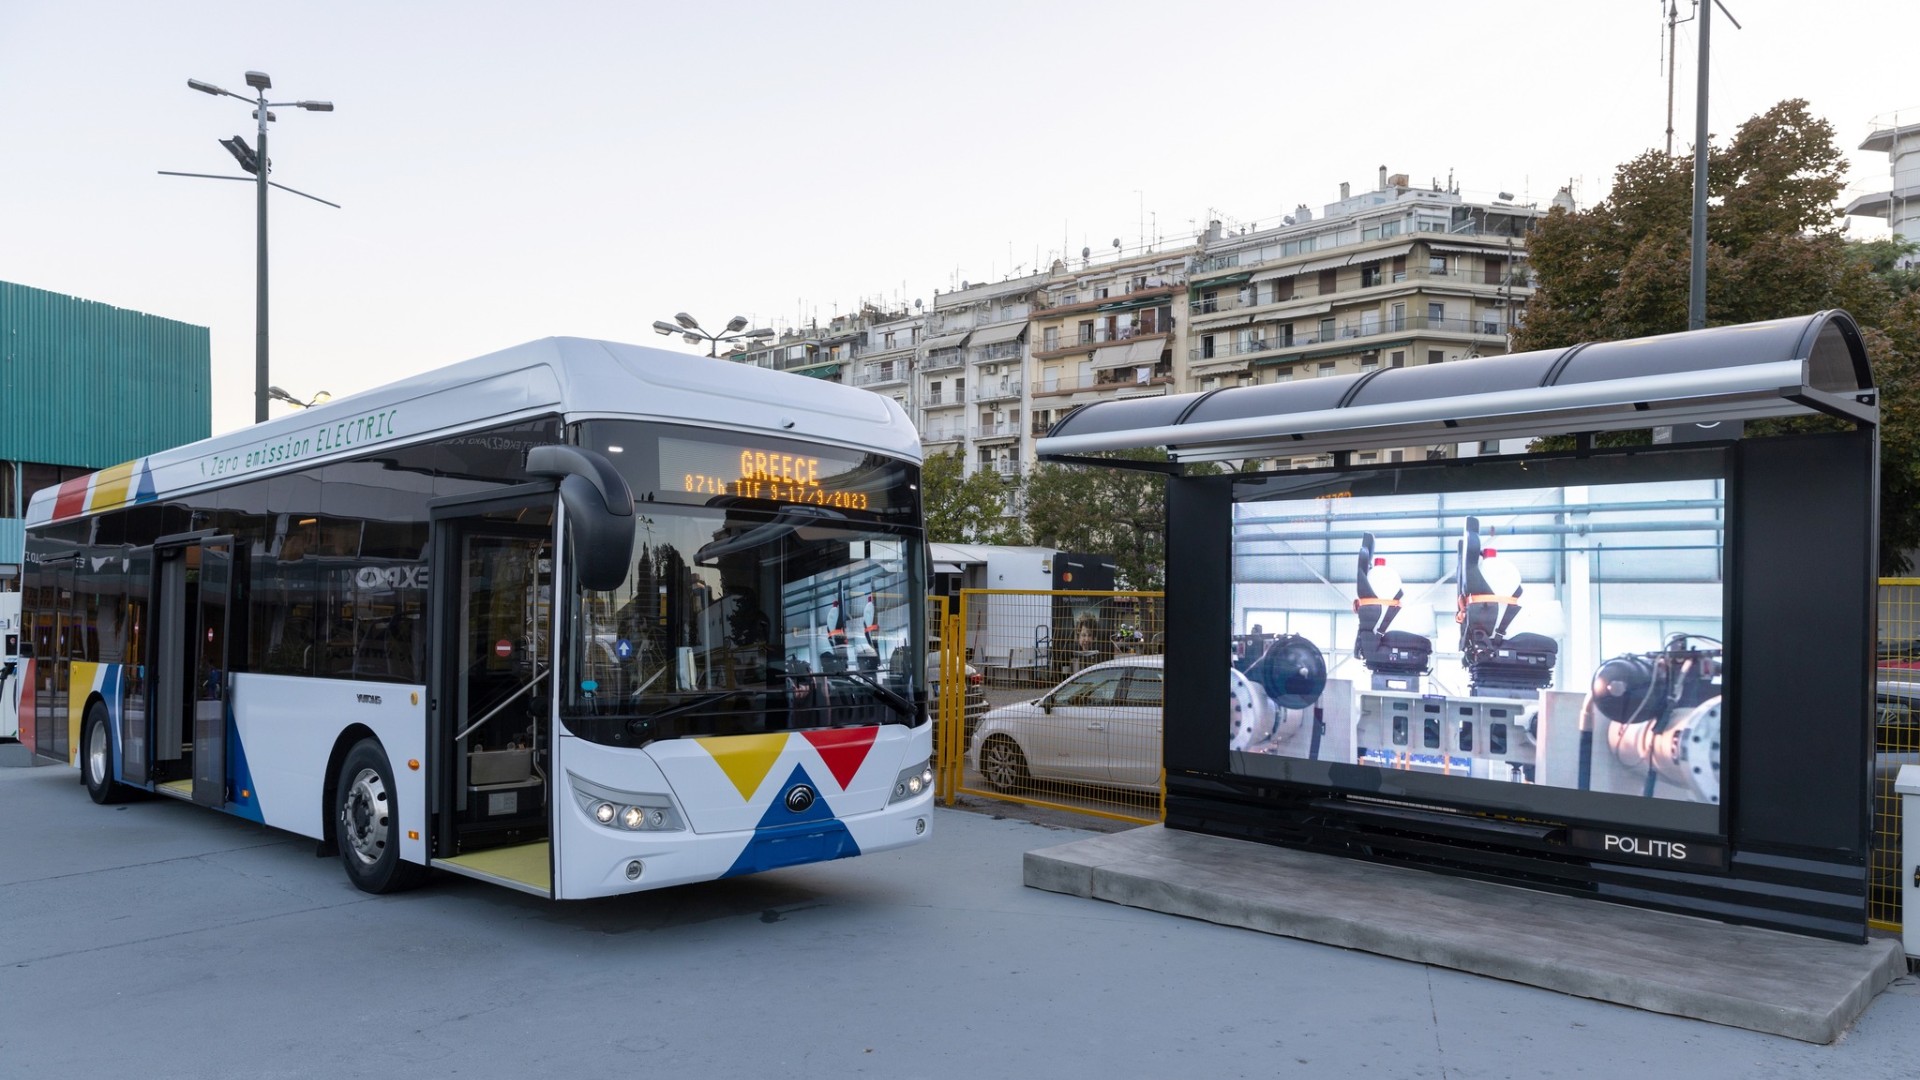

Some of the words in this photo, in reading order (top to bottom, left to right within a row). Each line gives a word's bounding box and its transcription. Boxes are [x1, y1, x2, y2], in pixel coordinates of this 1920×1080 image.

[210, 456, 238, 477] Zero
[245, 436, 310, 469] emission
[316, 409, 397, 453] ELECTRIC
[740, 450, 819, 487] GREECE
[684, 473, 727, 495] 87th
[735, 479, 761, 499] TIF
[770, 483, 867, 510] 9-17/9/2023
[1604, 834, 1687, 860] POLITIS
